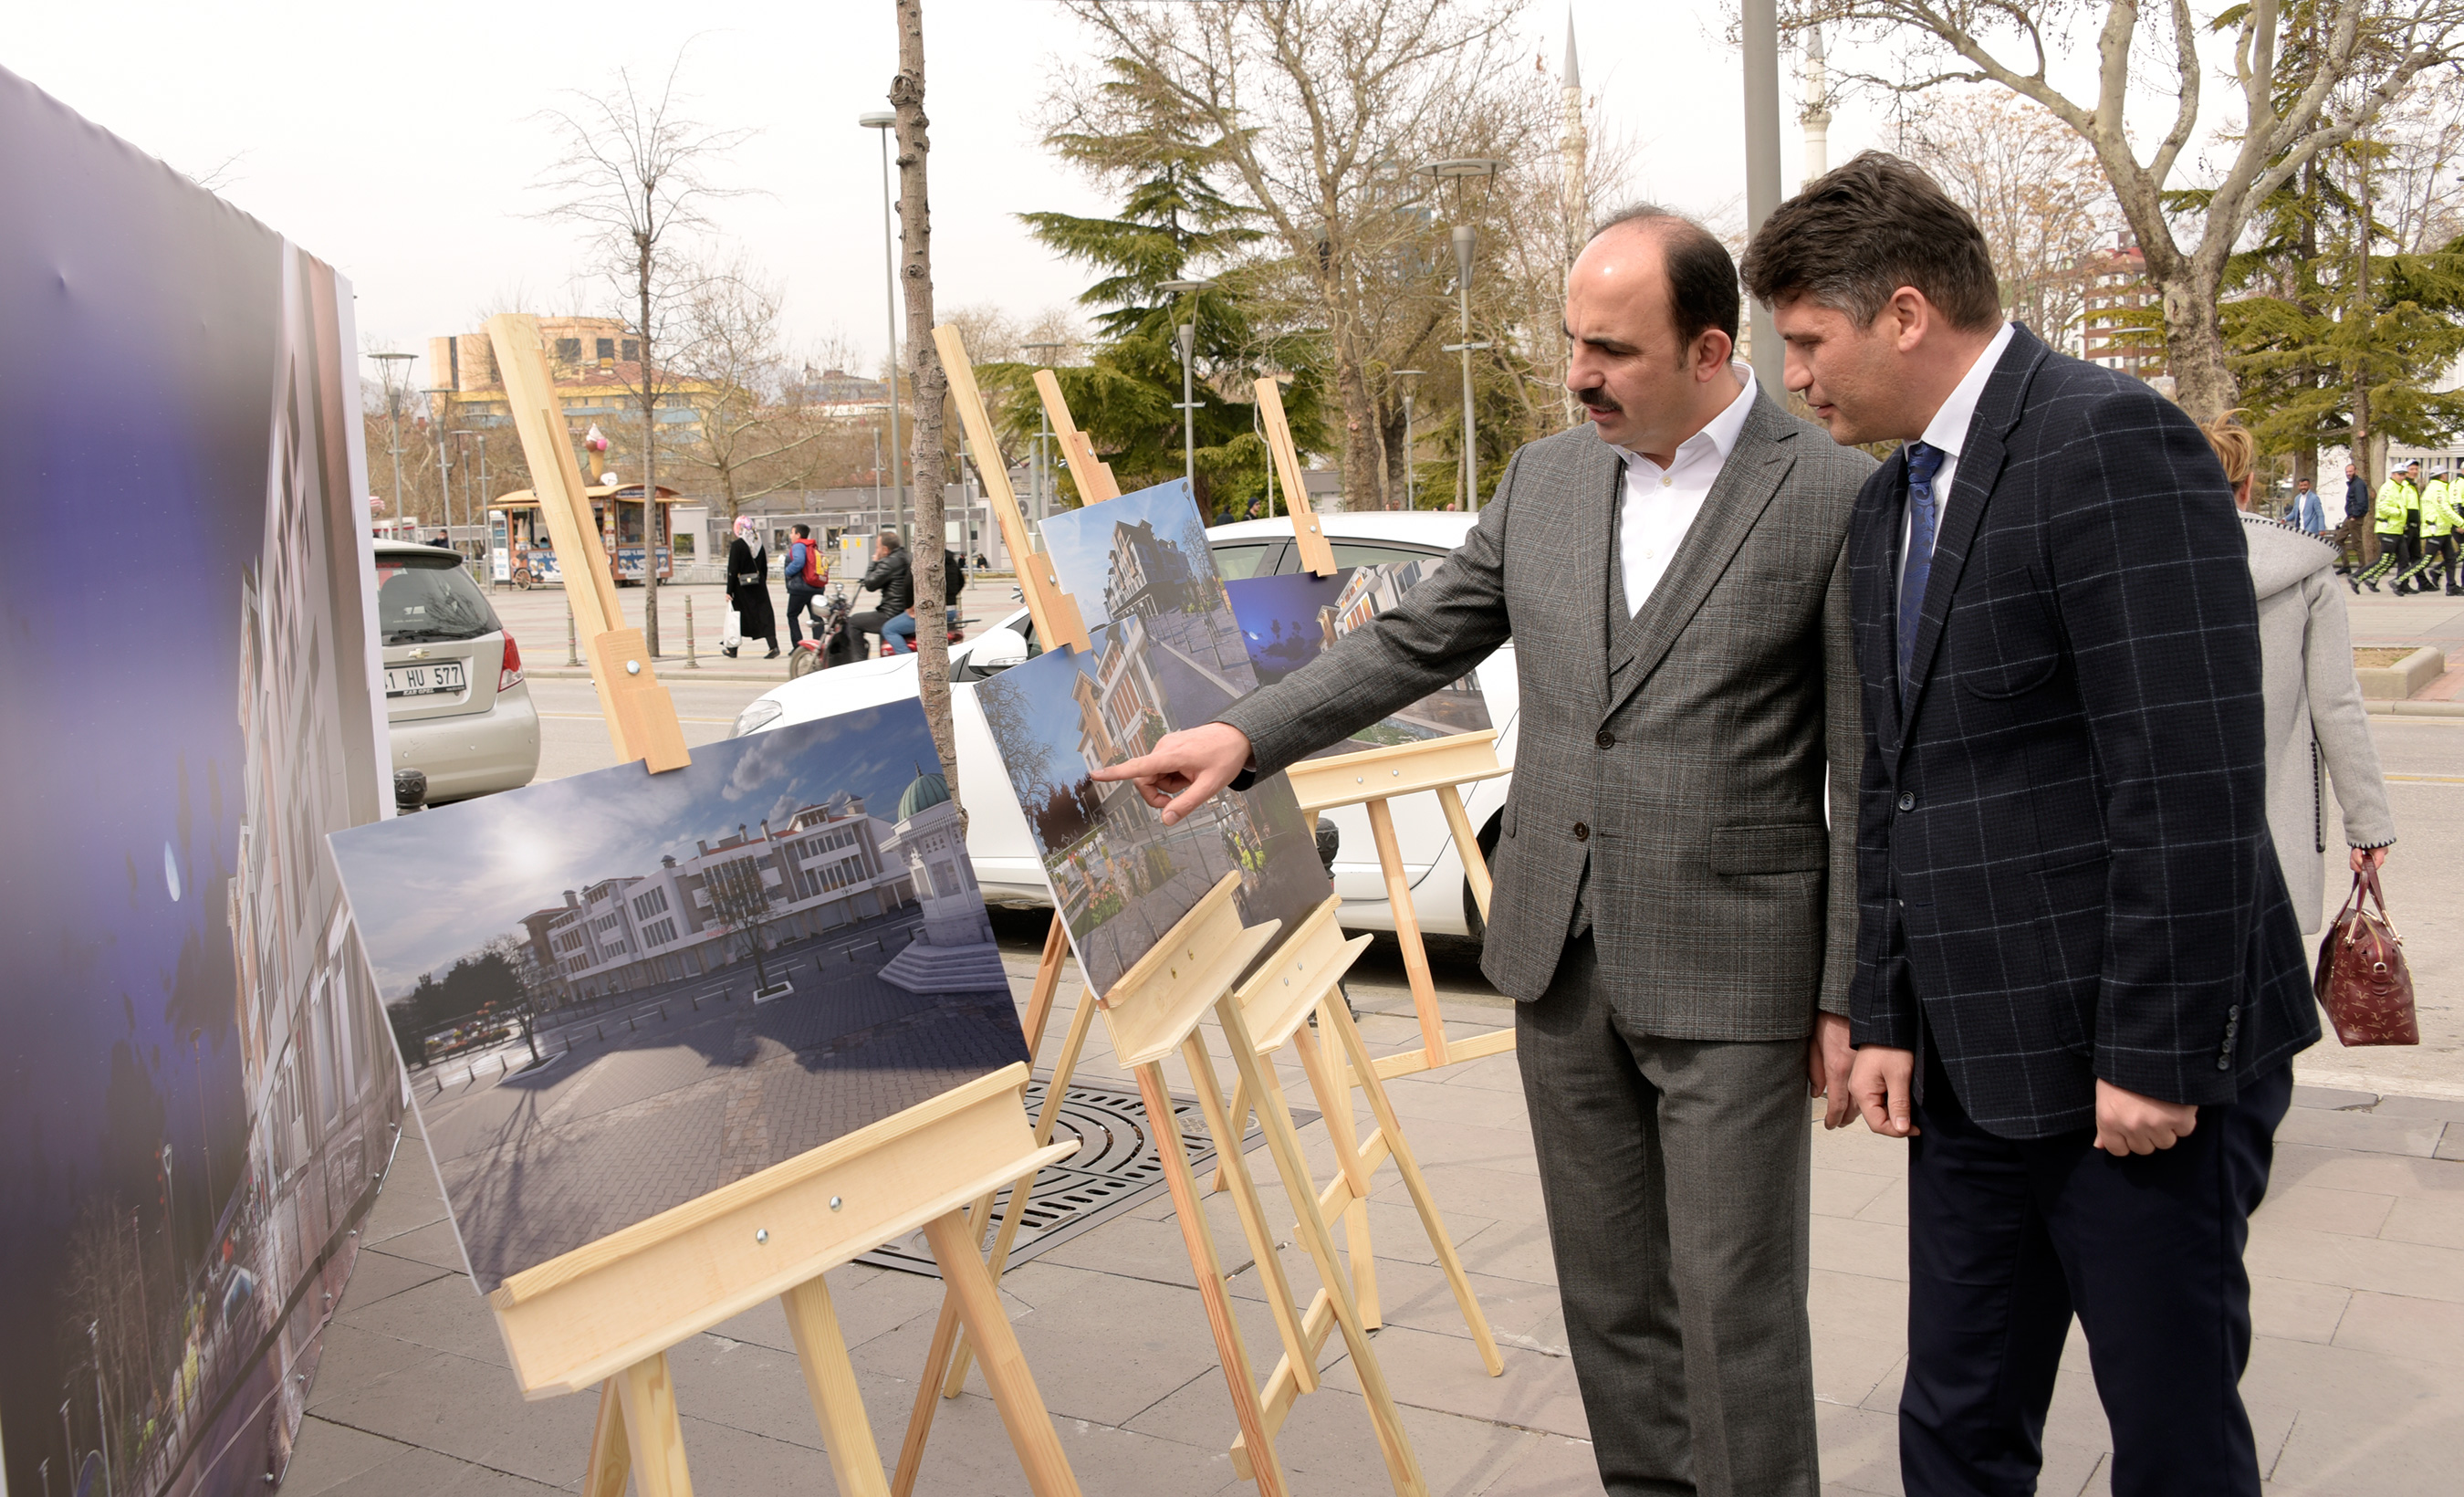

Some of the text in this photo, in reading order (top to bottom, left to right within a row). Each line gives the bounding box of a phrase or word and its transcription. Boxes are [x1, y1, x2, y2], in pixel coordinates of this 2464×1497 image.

[385, 666, 458, 689] 1 HU 577
